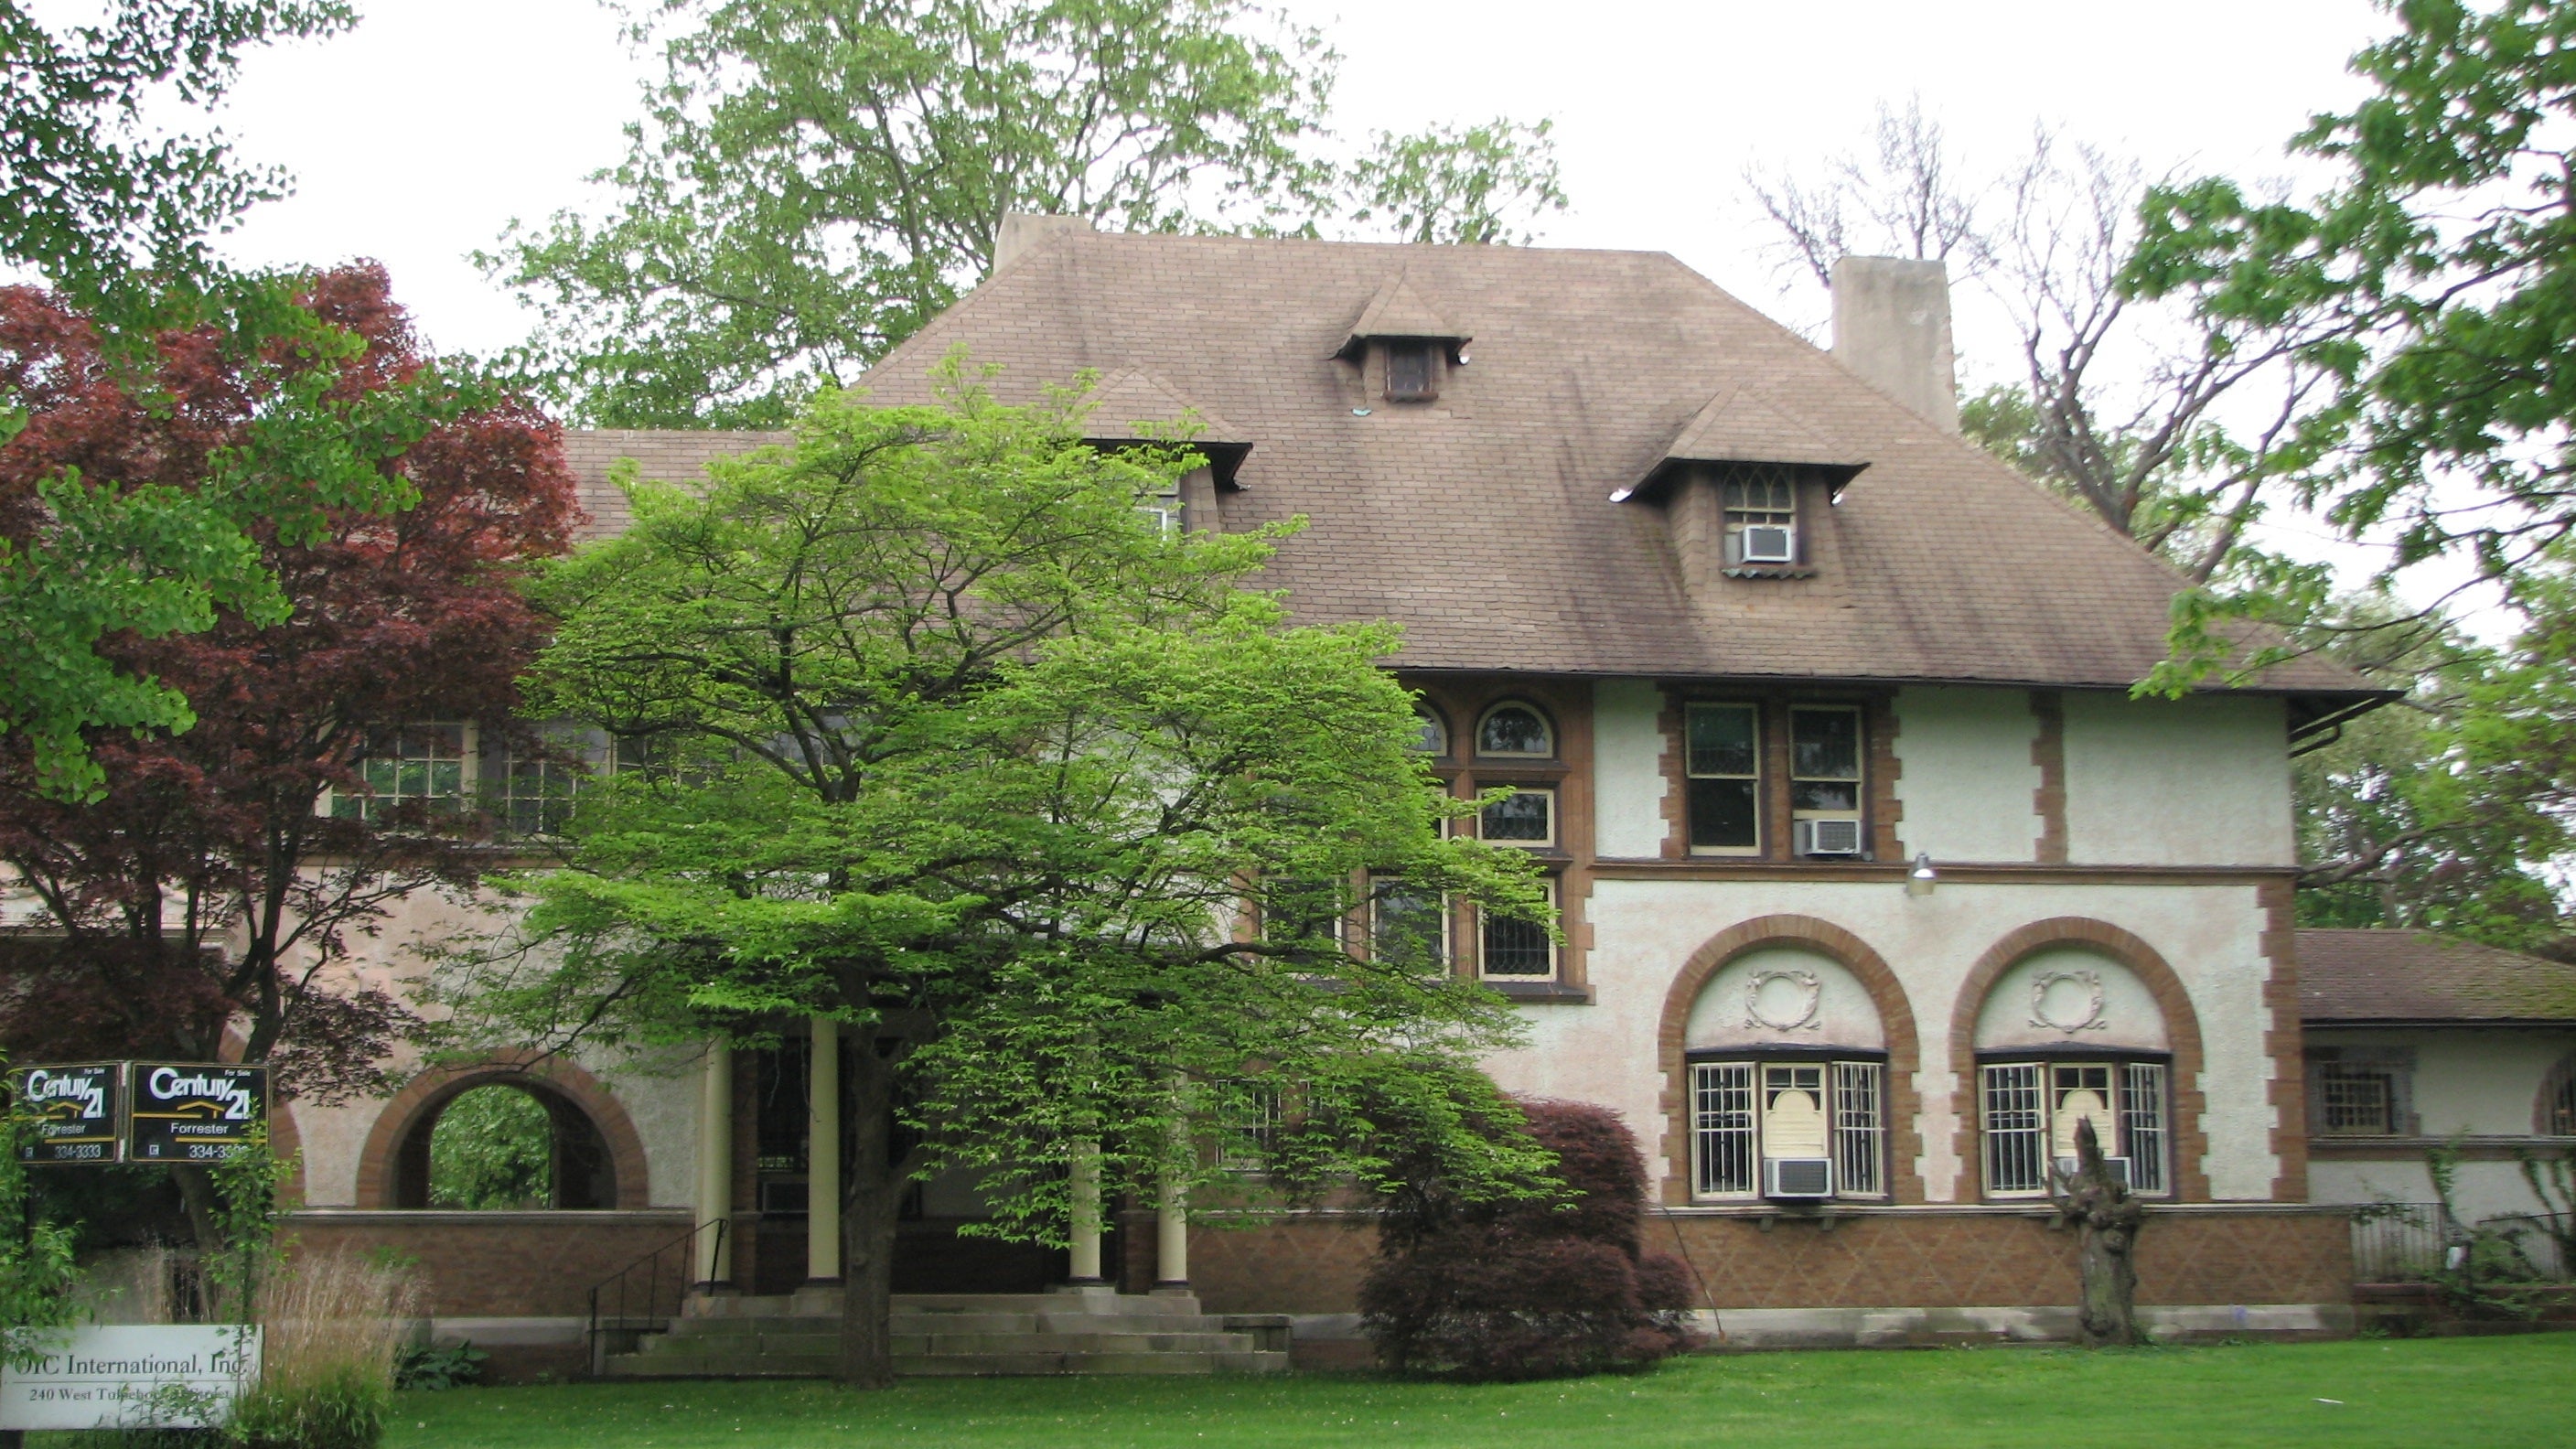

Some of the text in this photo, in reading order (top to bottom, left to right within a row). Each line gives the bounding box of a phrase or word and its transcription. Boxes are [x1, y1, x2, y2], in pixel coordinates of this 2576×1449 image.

[27, 1069, 103, 1119] Century 21
[149, 1067, 251, 1120] Century 21
[41, 1124, 86, 1136] Forrester
[170, 1122, 230, 1134] Forrester
[15, 1354, 59, 1375] OIC
[67, 1353, 202, 1376] International,
[29, 1389, 55, 1401] 240
[59, 1388, 92, 1401] West
